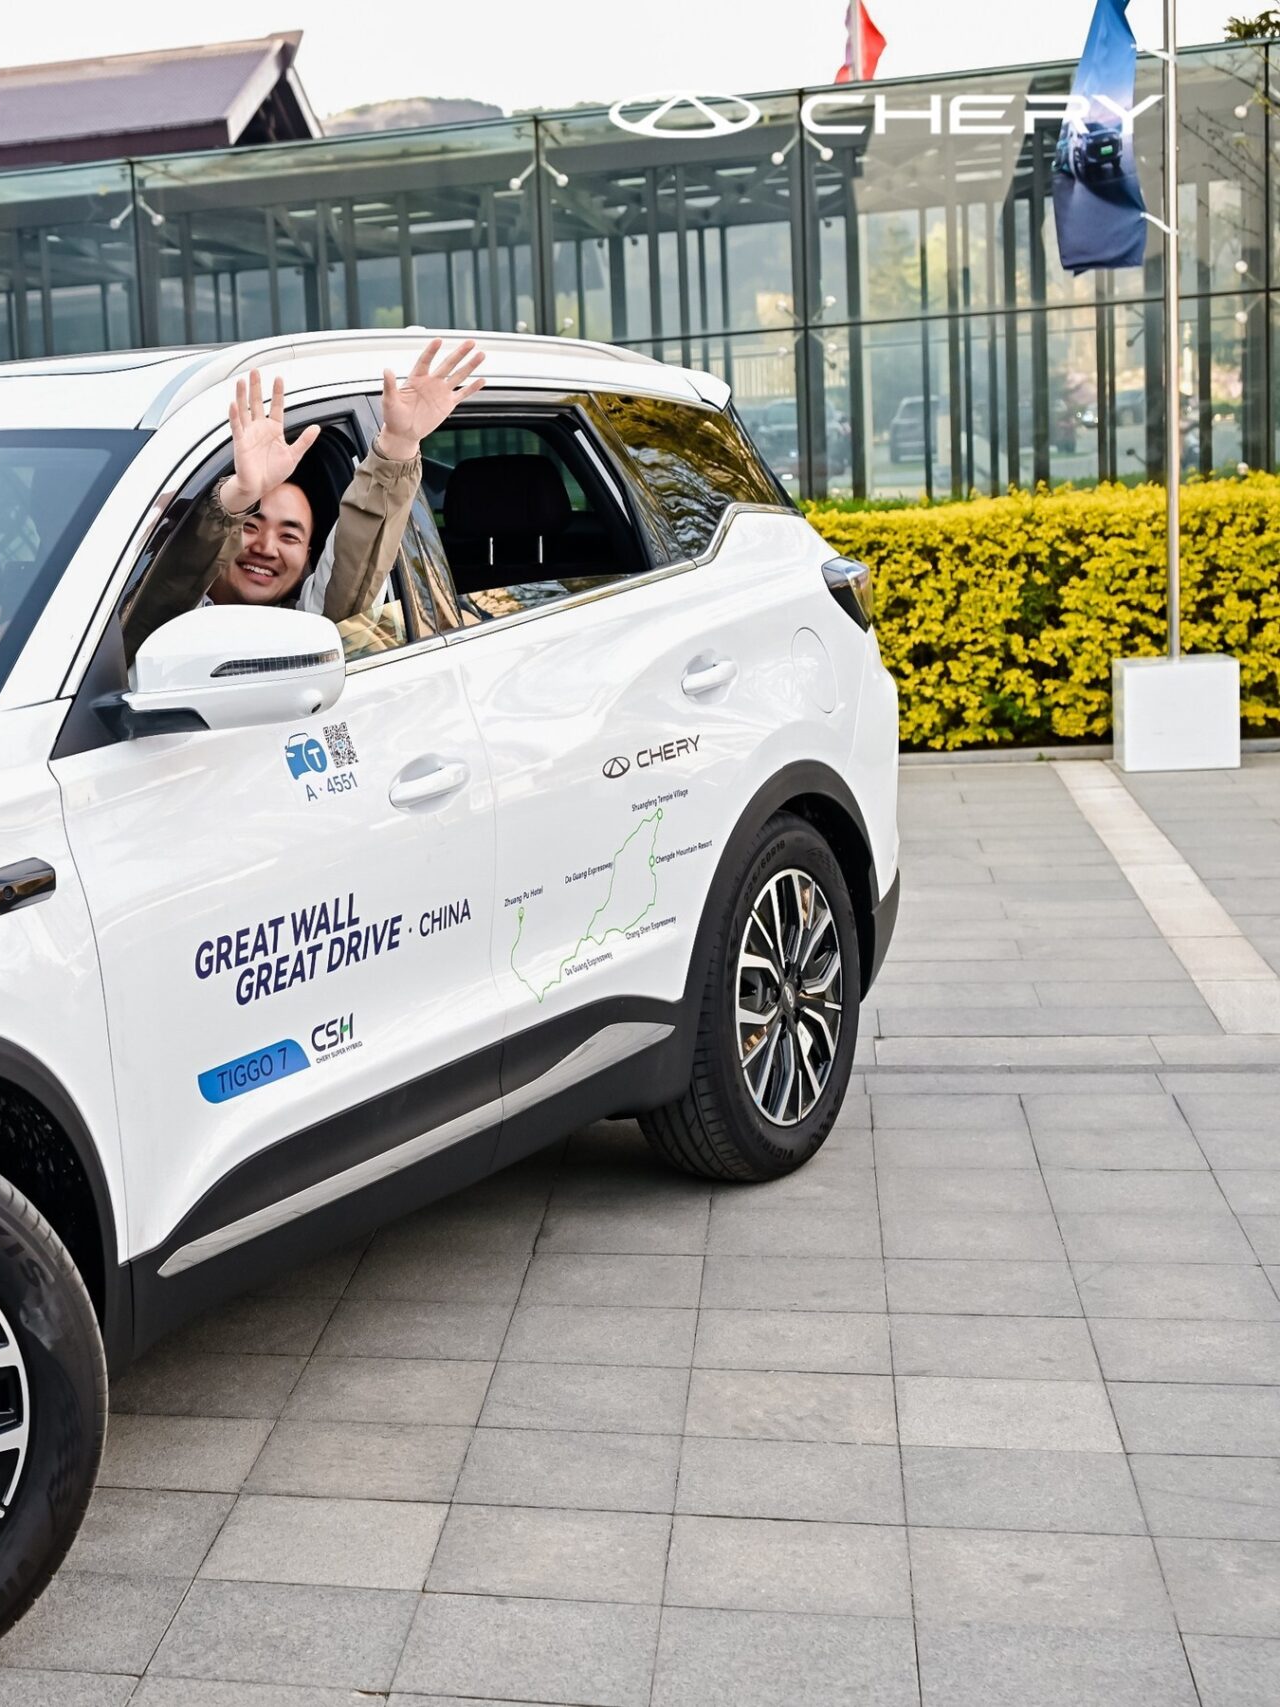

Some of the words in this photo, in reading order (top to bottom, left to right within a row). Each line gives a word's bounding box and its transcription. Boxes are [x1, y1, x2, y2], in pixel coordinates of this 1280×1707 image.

[636, 734, 700, 768] CHERY
[631, 797, 657, 812] Shuangfeng
[657, 792, 673, 804] Temple
[673, 788, 689, 801] Village
[655, 850, 675, 865] Chengde
[675, 844, 698, 859] Mountain
[698, 839, 713, 853] Resort
[565, 875, 572, 885] Da
[572, 869, 588, 883] Guang
[587, 861, 614, 877] Expressway
[504, 894, 523, 908] Zhuang
[523, 891, 530, 902] Pu
[530, 886, 544, 899] Hotel
[195, 916, 285, 980] GREAT
[291, 892, 360, 946] WALL
[640, 924, 651, 937] Shen
[651, 915, 677, 931] Expressway
[236, 943, 323, 1006] GREAT
[326, 914, 403, 974] DRIVE
[419, 898, 471, 937] CHINA
[572, 961, 587, 975] Guang
[587, 951, 613, 969] Expressway
[311, 1012, 354, 1052] CSH
[315, 1053, 331, 1065] CHERY
[331, 1047, 346, 1059] SUPER
[346, 1040, 363, 1053] HYBRID
[217, 1054, 273, 1093] TIGGO
[278, 1047, 288, 1070] 7
